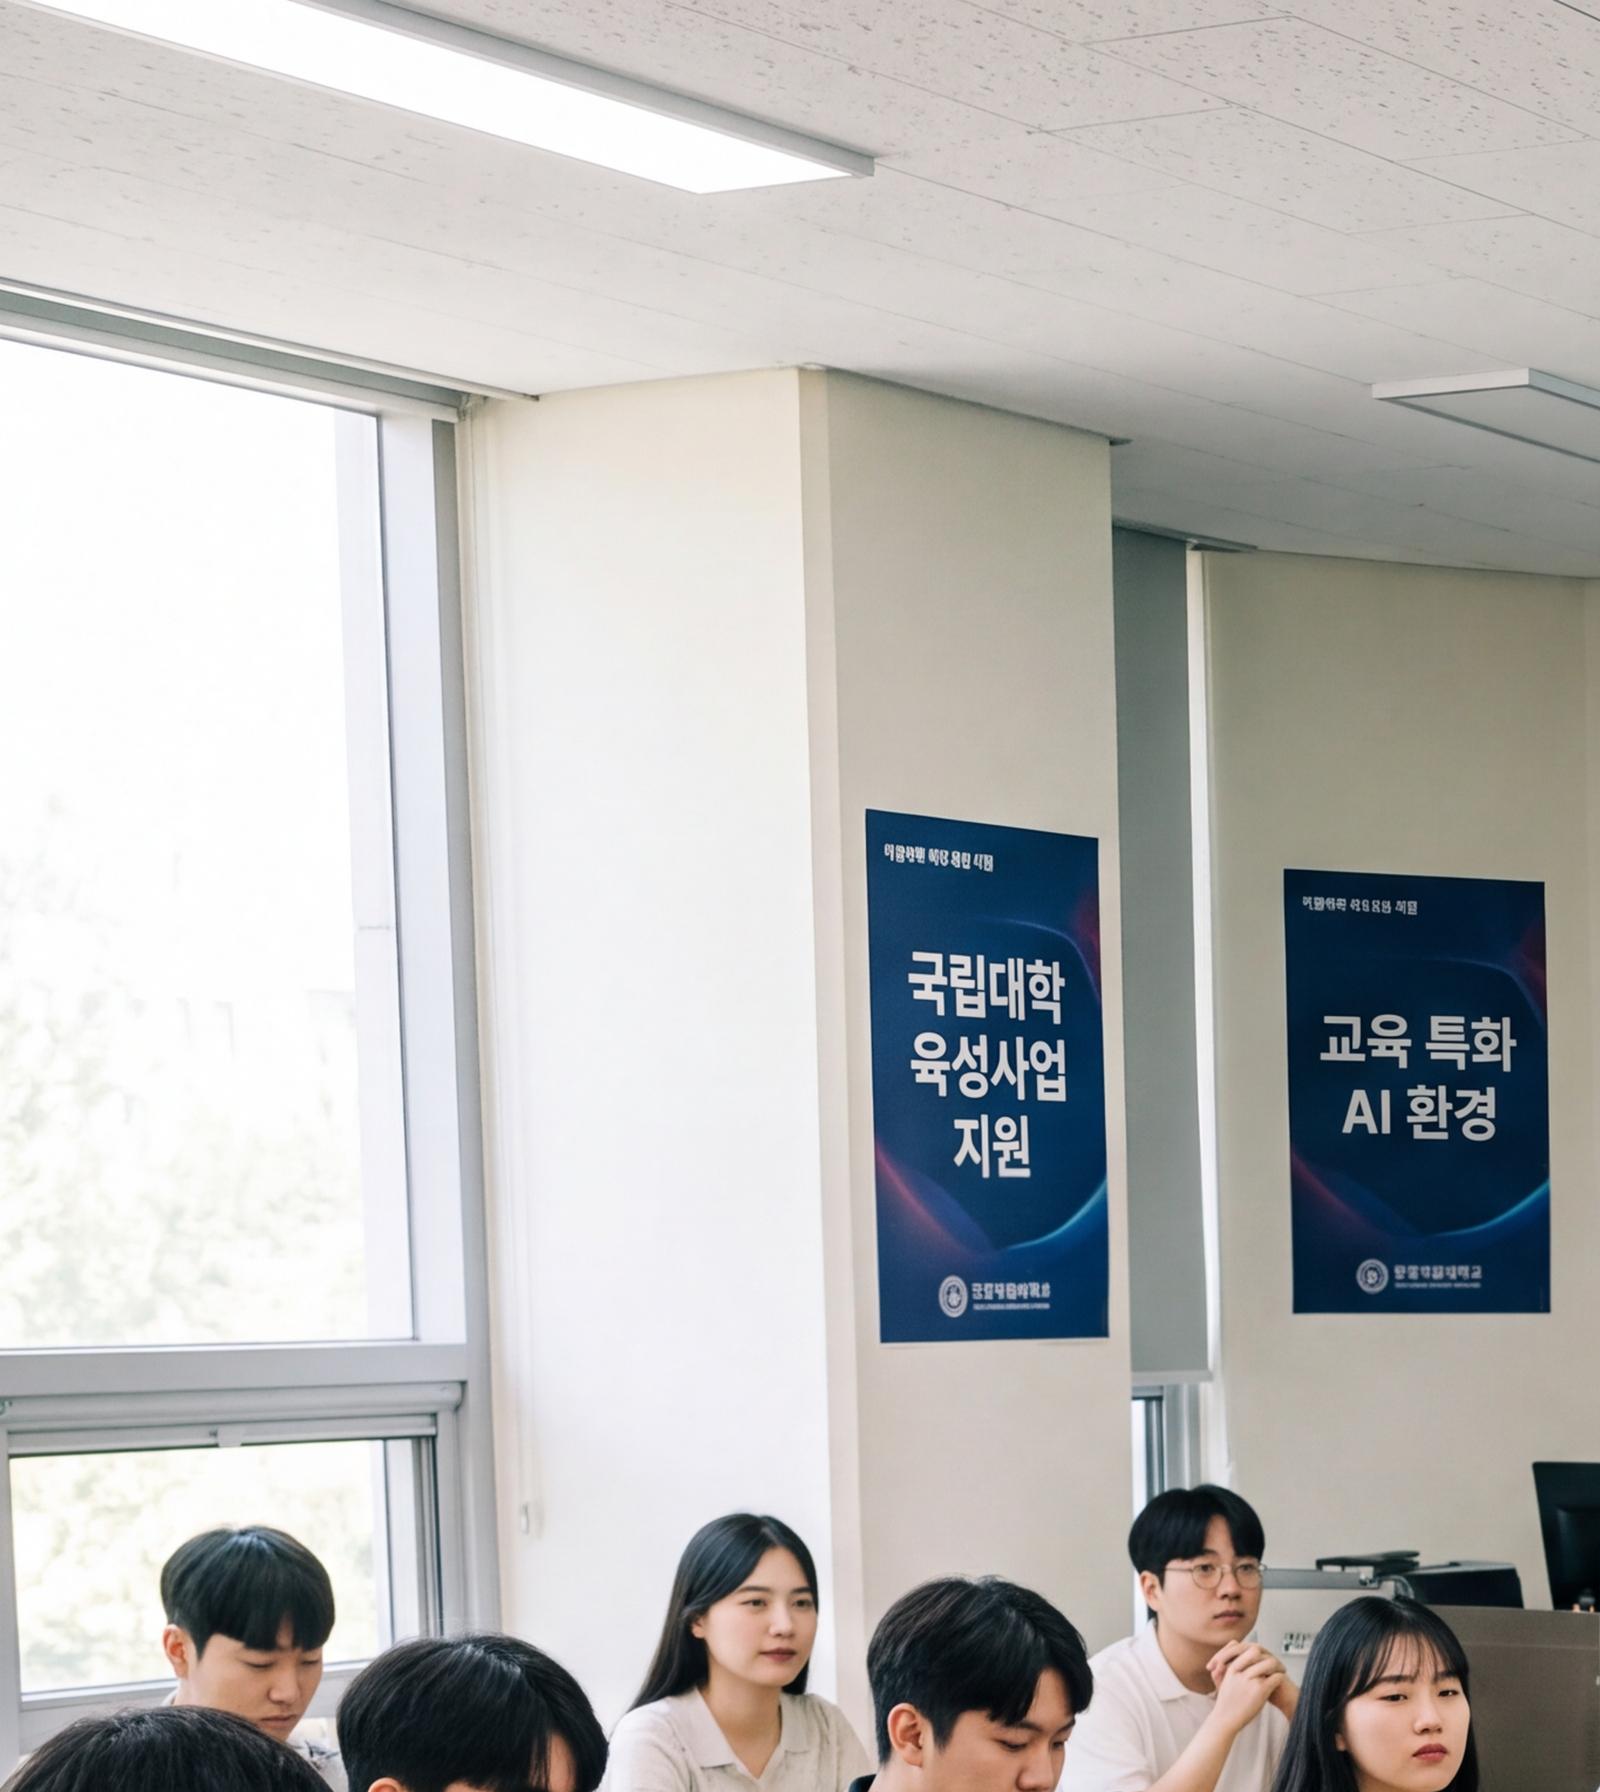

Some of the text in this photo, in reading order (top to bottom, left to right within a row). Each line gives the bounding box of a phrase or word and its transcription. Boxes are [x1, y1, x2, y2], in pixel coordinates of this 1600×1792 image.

[907, 951, 1066, 1025] 국립대학
[910, 1031, 1067, 1102] 육성사업
[1319, 1013, 1518, 1073] 교육 특화
[953, 1113, 1031, 1179] 지원
[1341, 1084, 1496, 1142] AI 환경
